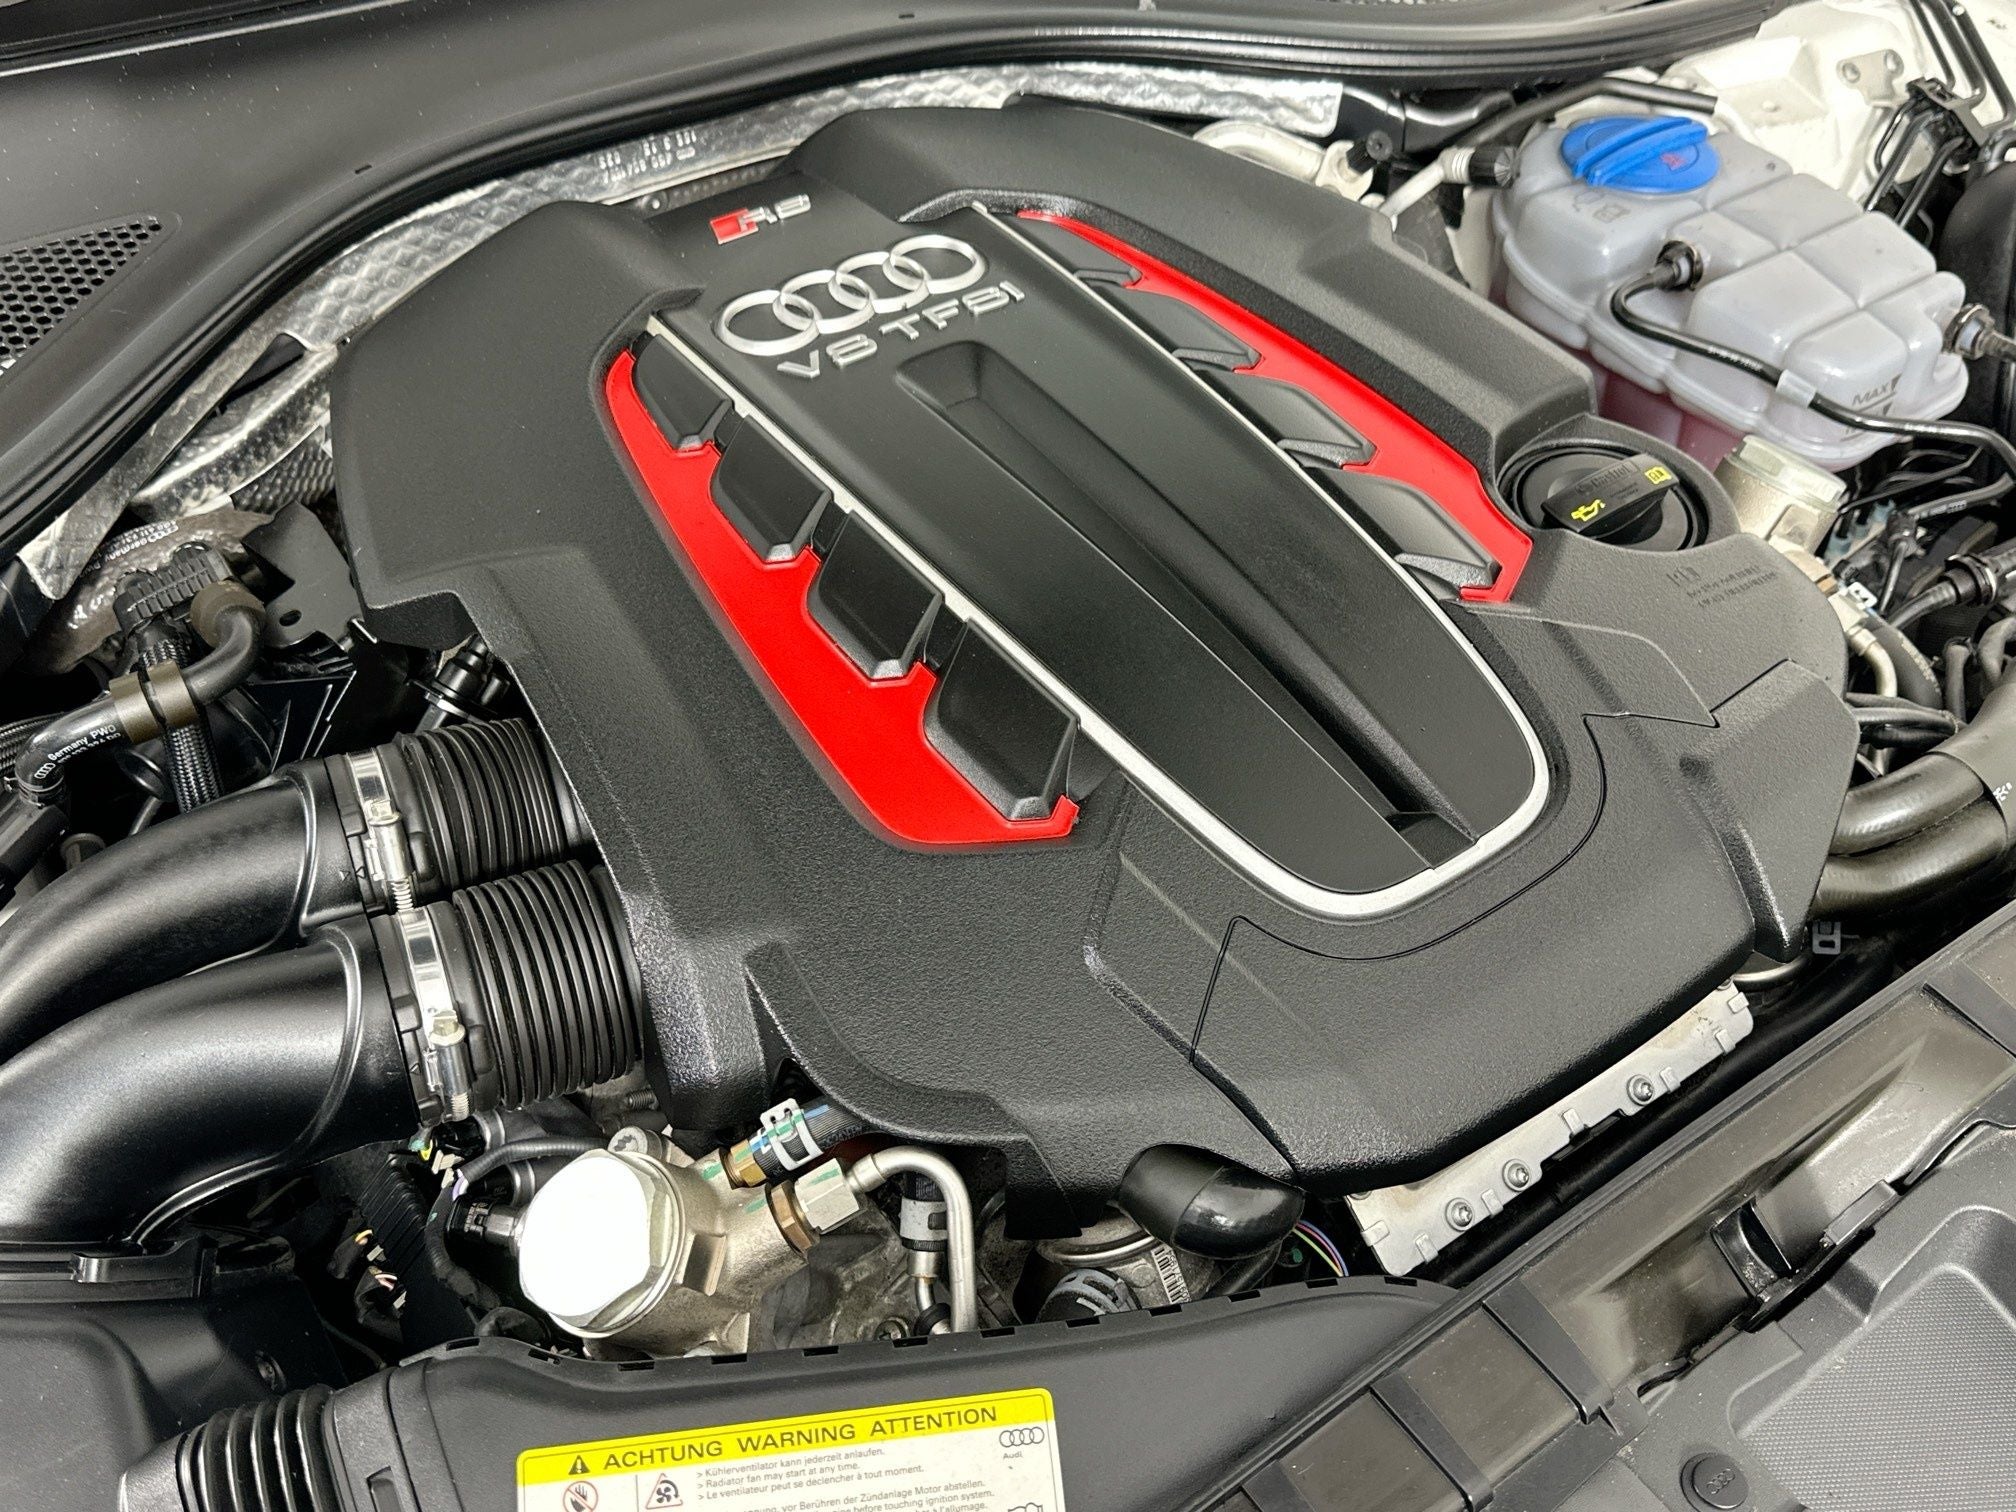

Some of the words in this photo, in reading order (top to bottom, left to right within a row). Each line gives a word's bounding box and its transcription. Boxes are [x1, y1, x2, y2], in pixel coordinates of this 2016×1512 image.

[879, 280, 1026, 341] TFSI
[47, 736, 89, 761] Germany
[603, 1440, 723, 1470] ACHTUNG
[736, 1423, 856, 1453] WARNING
[869, 1405, 997, 1437] ATTENTION
[705, 1460, 778, 1477] Kühlerventilator
[780, 1457, 802, 1468] kann
[804, 1452, 842, 1467] jederzeit
[844, 1447, 885, 1460] anlaufen.
[1002, 1450, 1024, 1460] Audi
[706, 1476, 744, 1489] Radiator
[747, 1473, 761, 1484] fan
[764, 1472, 783, 1484] may
[785, 1468, 805, 1479] start
[808, 1466, 817, 1476] at
[819, 1465, 835, 1476] any
[837, 1460, 861, 1472] time.
[706, 1488, 718, 1500] Le
[720, 1483, 768, 1498] ventilateur
[771, 1481, 791, 1493] peut
[793, 1480, 804, 1489] se
[864, 1470, 883, 1480] tout
[885, 1464, 924, 1477] moment.
[799, 1498, 841, 1511] Berühren
[843, 1495, 858, 1505] der
[914, 1485, 942, 1496] Motor
[943, 1480, 986, 1492] abstellen.
[884, 1499, 923, 1511] touching
[925, 1494, 959, 1507] ignition
[960, 1489, 995, 1502] system.
